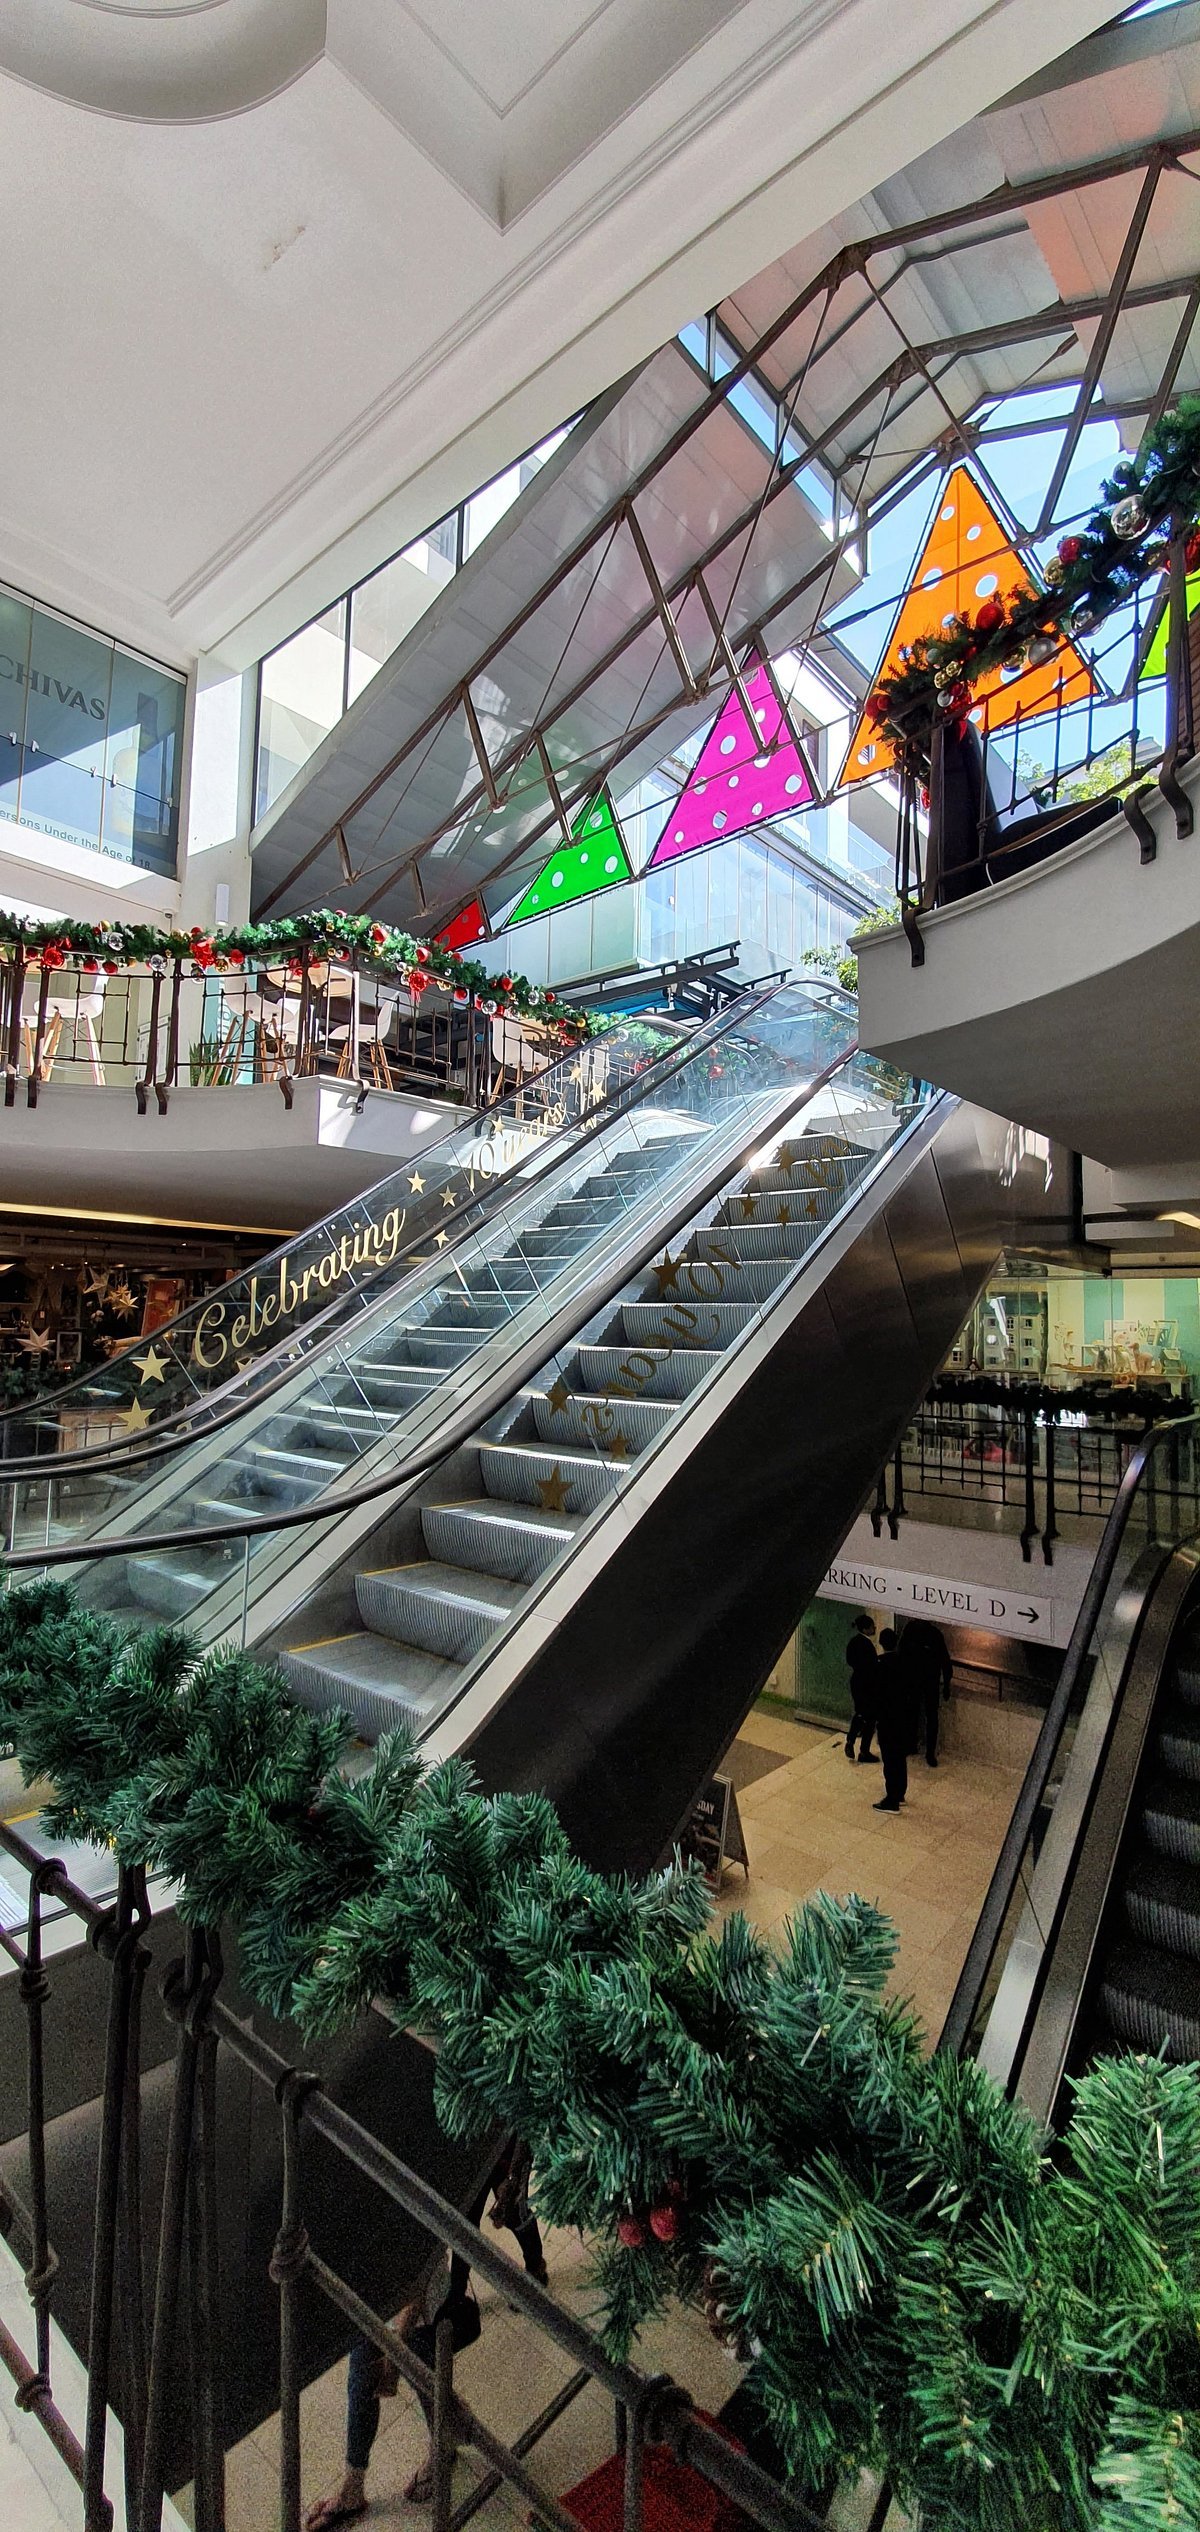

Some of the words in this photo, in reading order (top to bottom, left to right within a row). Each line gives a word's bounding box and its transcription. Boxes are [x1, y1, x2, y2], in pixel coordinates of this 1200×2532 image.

[0, 654, 105, 721] CHIVAS
[44, 824, 78, 843] Under
[81, 838, 98, 851] the
[102, 845, 123, 860] Age
[194, 1207, 406, 1368] Celebrating
[823, 1568, 887, 1594] RKING
[912, 1584, 978, 1613] LEVEL
[989, 1599, 1006, 1618] D
